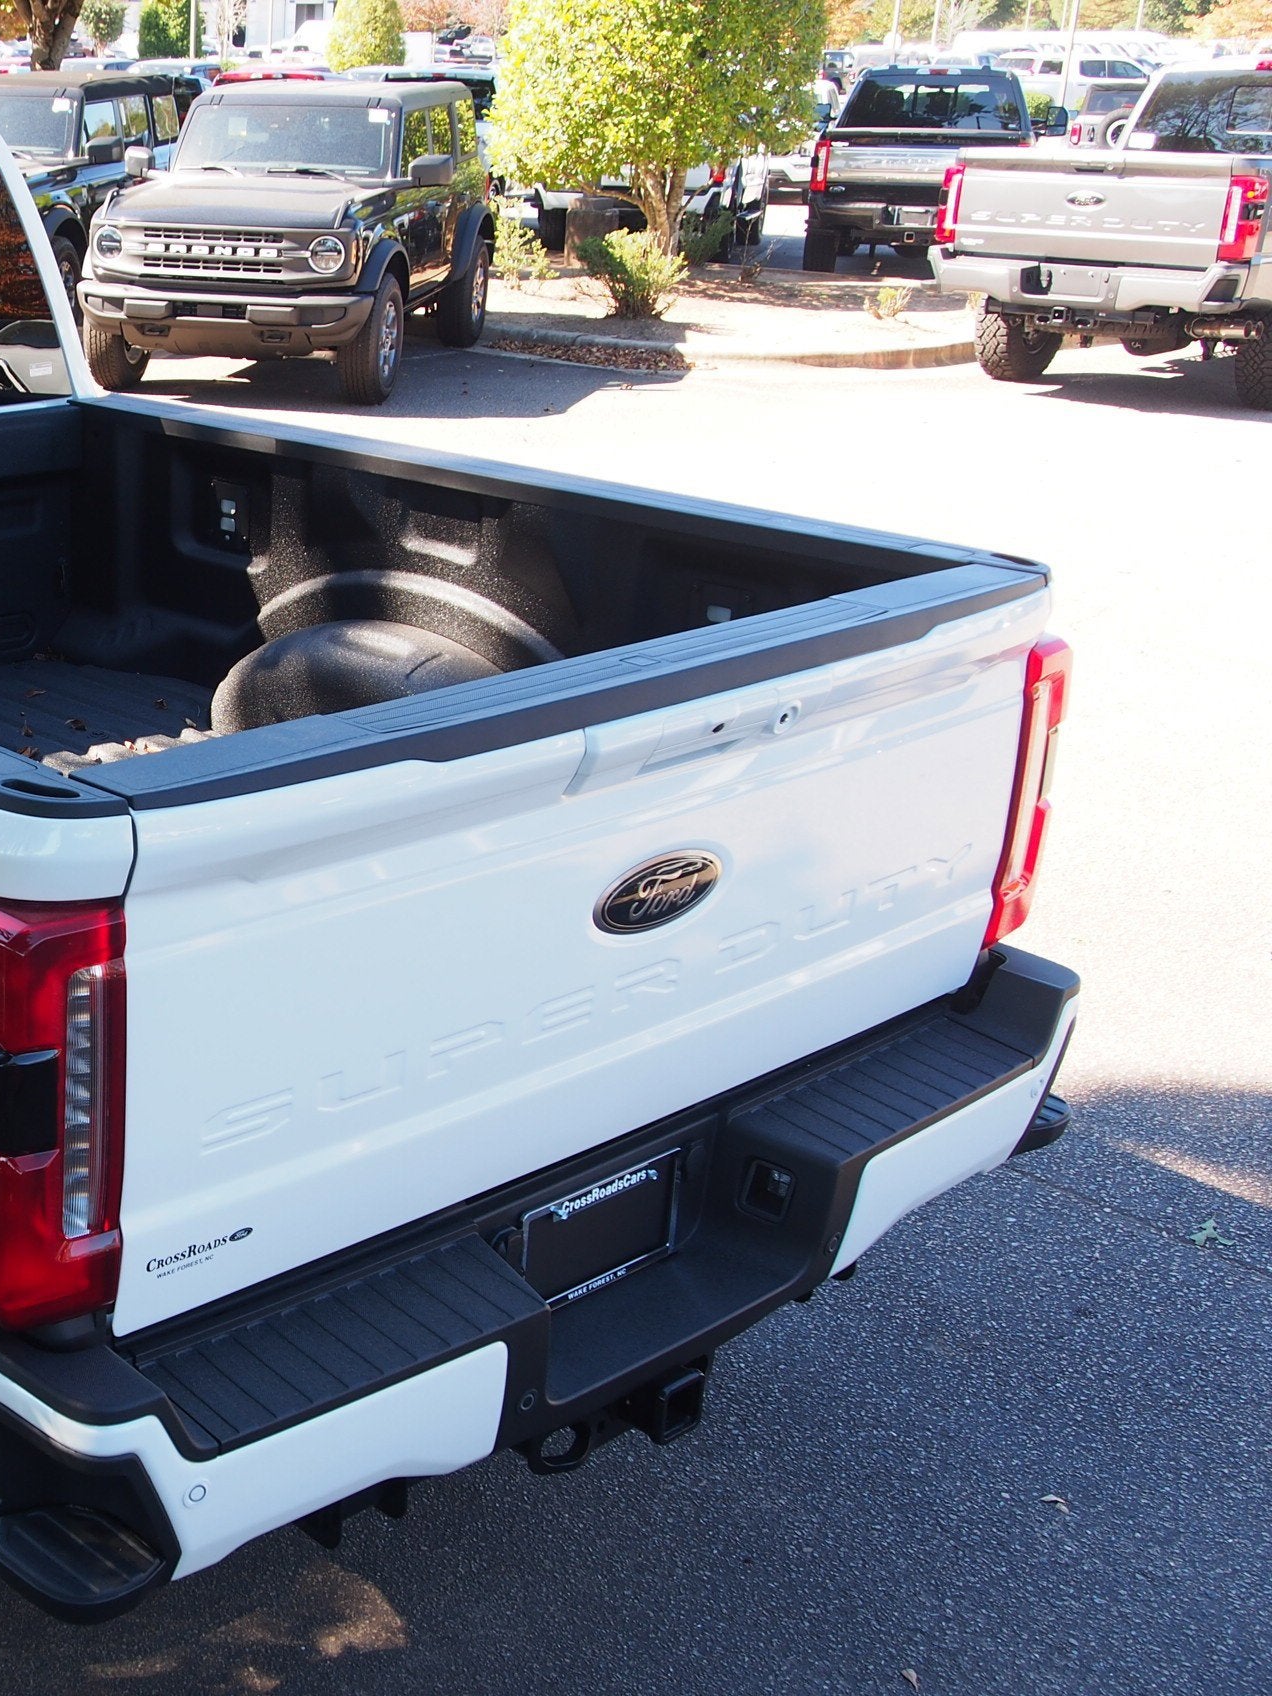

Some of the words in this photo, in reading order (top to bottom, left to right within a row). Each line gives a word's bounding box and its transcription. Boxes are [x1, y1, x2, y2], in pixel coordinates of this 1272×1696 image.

[970, 210, 1093, 228] SUPER
[1101, 216, 1205, 233] DUTY
[629, 860, 704, 921] Ford
[200, 957, 683, 1157] SUPER
[712, 842, 974, 975] DUTY
[561, 1168, 648, 1214] CrossRoadsCars
[156, 1268, 175, 1279] WAKE
[204, 1254, 214, 1262] NC
[568, 1286, 587, 1300] WAKE
[589, 1273, 616, 1290] FOREST,
[617, 1268, 627, 1277] NC
